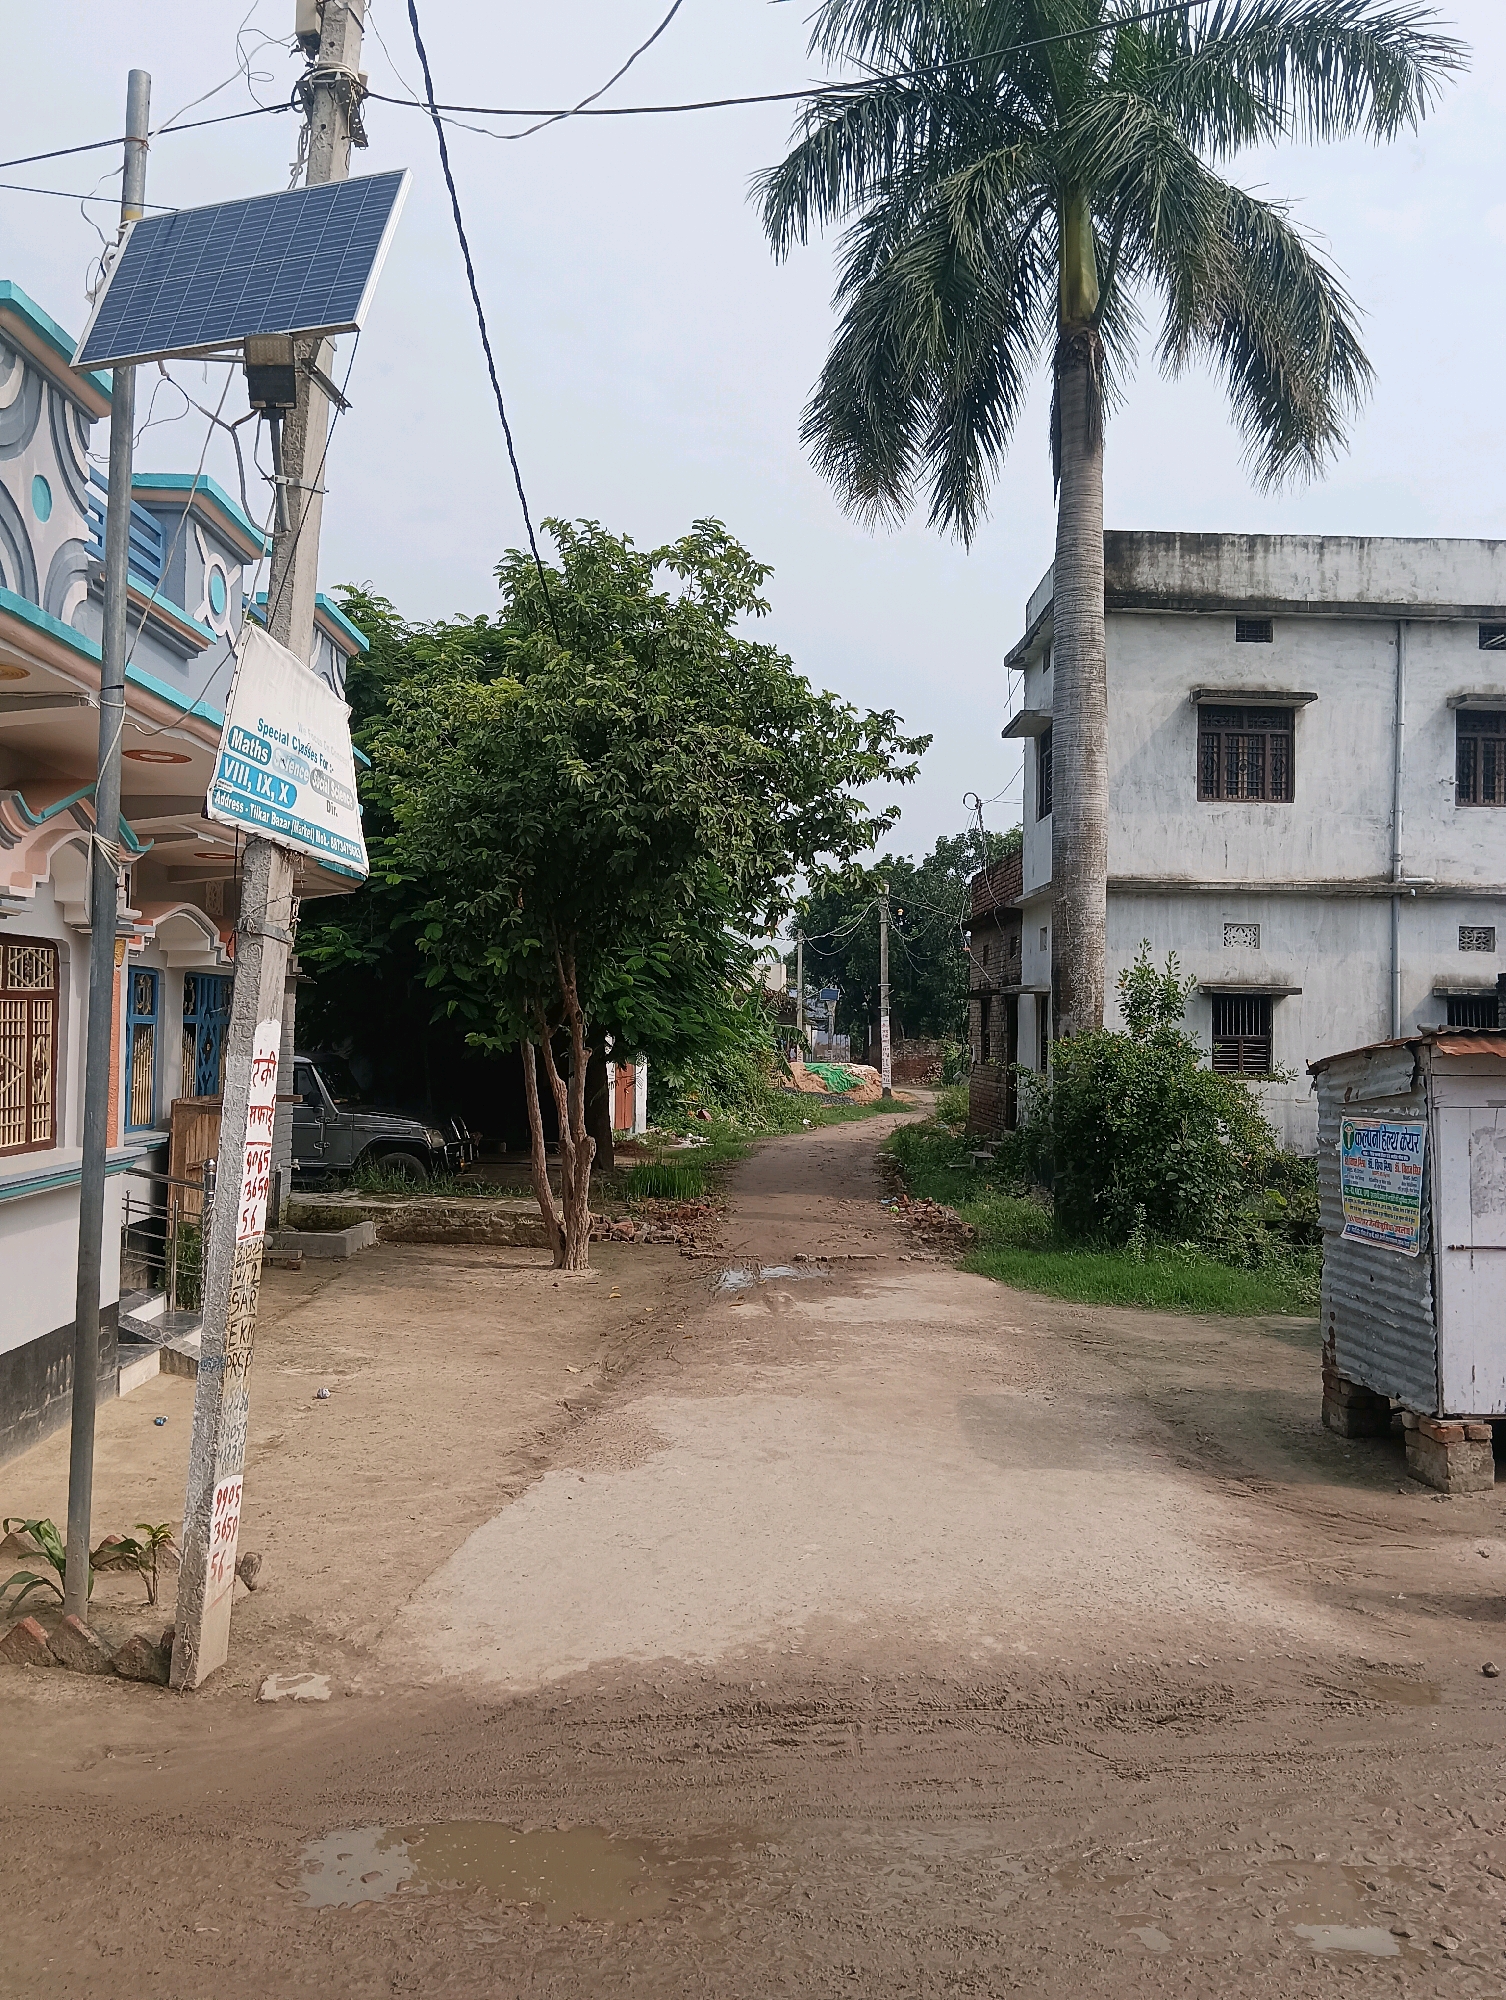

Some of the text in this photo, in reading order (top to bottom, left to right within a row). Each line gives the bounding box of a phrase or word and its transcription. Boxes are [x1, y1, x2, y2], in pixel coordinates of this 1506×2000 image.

[257, 717, 289, 747] Special
[292, 735, 318, 764] Classes
[223, 756, 251, 792] VIII,
[256, 772, 275, 798] IX,
[279, 782, 289, 804] X
[231, 728, 353, 808] Maths Science Social Science
[214, 790, 244, 813] Address
[271, 813, 291, 830] Bazar
[327, 800, 338, 817] Dir.
[249, 1094, 276, 1136] सफाई
[1355, 1125, 1420, 1154] कल्पना हेल्थ केयर
[243, 1176, 269, 1202] 3659
[242, 1204, 257, 1233] 56
[230, 1289, 257, 1316] SAR
[215, 1484, 242, 1517] 9905
